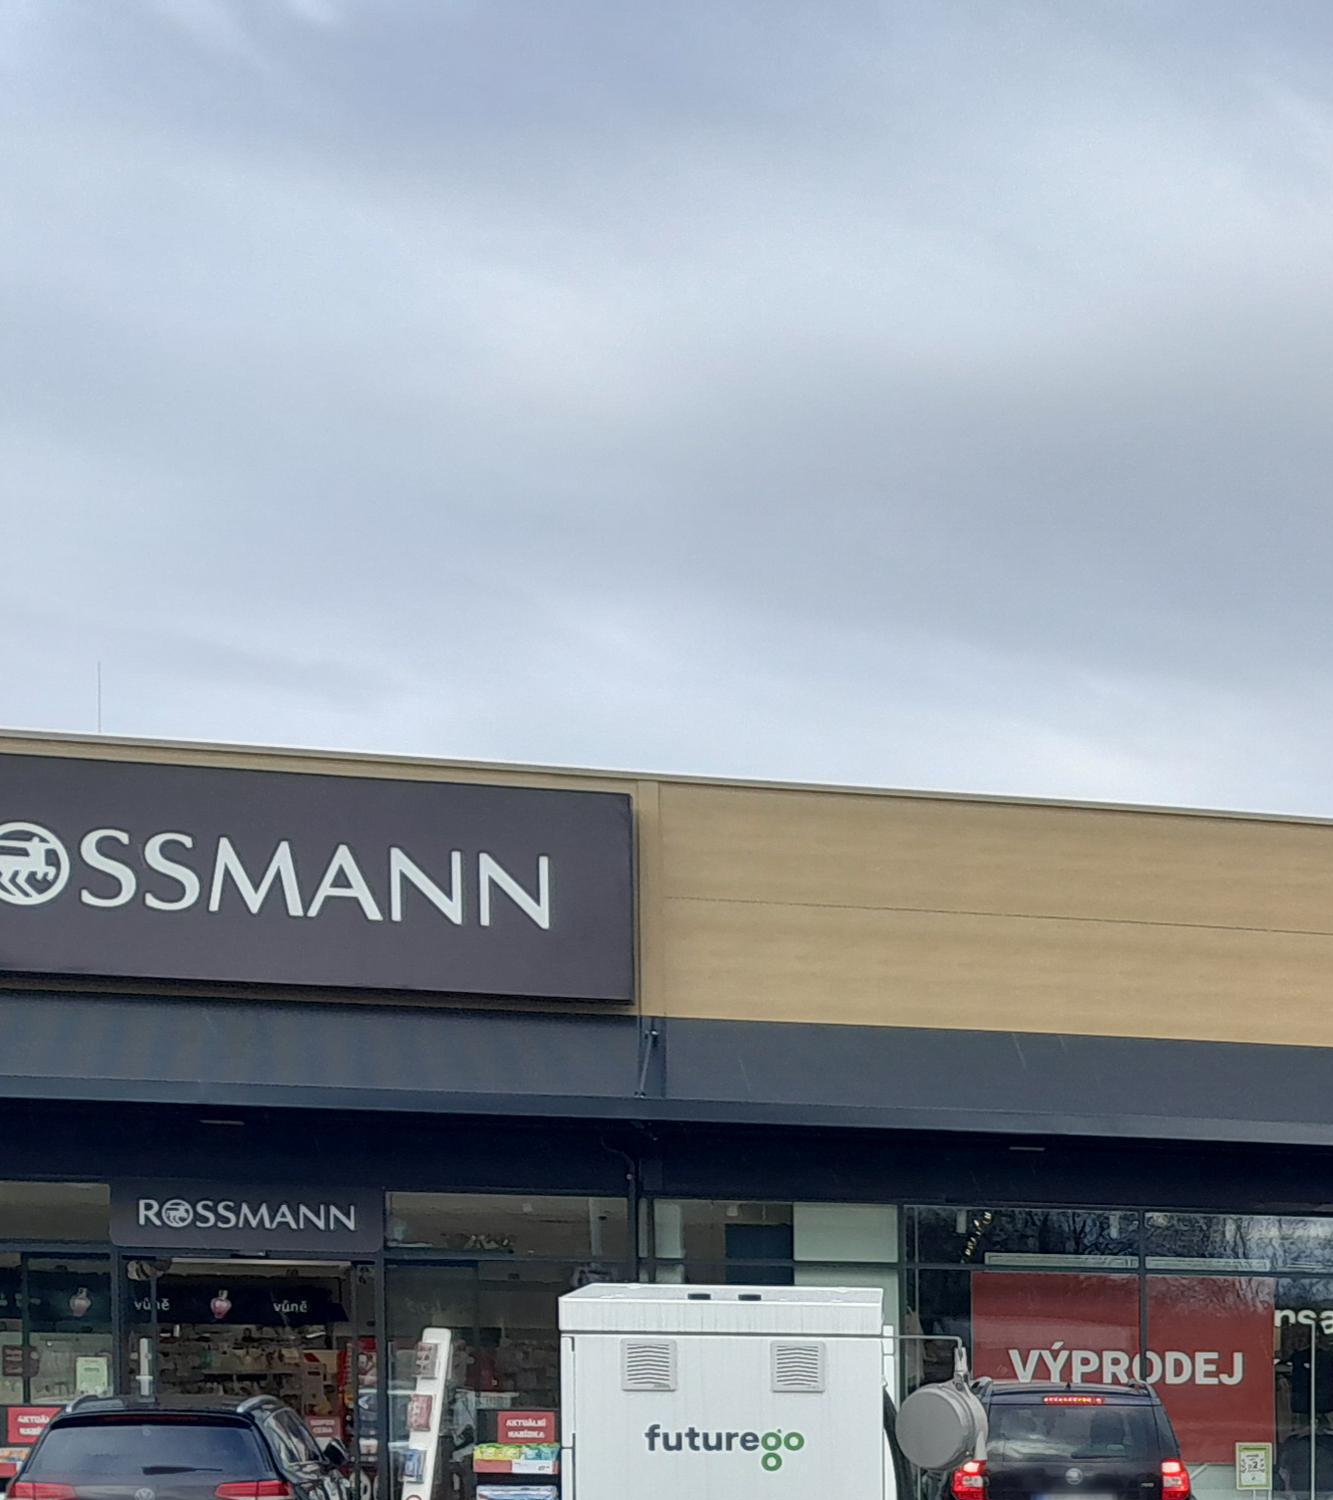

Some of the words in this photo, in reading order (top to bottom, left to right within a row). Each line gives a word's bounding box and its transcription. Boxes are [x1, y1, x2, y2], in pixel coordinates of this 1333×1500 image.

[138, 1199, 356, 1231] ROSSMANN
[273, 1299, 308, 1313] vůně
[1008, 1341, 1244, 1385] VÝPRODEJ
[644, 1423, 805, 1472] futurego
